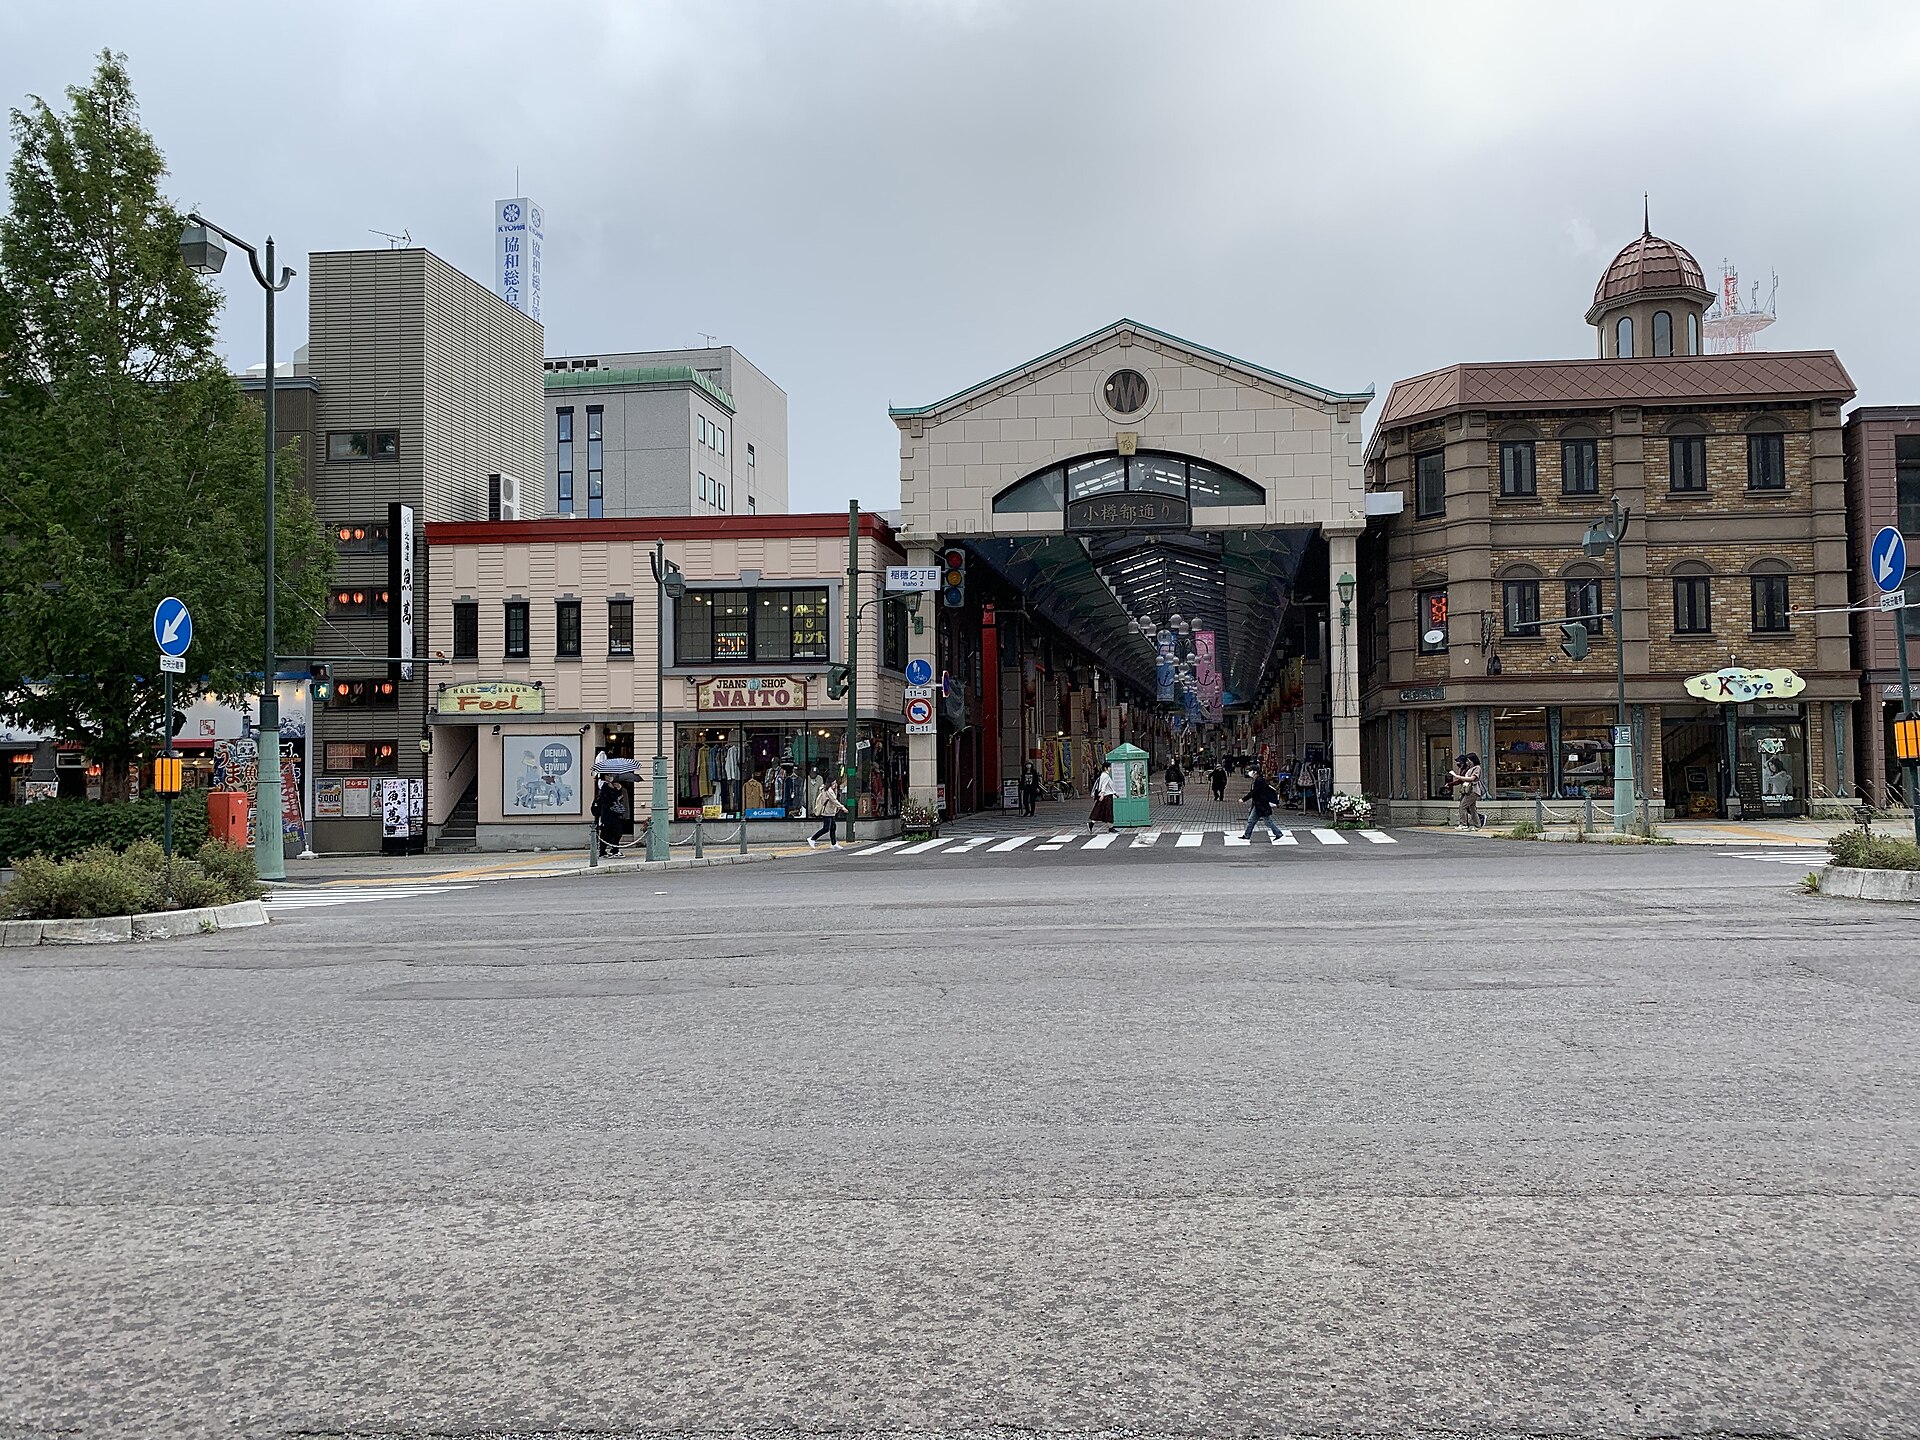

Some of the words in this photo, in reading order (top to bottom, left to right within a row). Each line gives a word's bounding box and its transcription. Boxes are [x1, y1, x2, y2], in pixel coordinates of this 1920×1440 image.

[1083, 503, 1172, 521] 小樽都通り
[890, 570, 937, 580] 稲穂2丁目
[793, 631, 826, 643] カット
[716, 679, 747, 689] JEANS
[761, 679, 786, 688] SHOP
[457, 695, 523, 711] Feel
[712, 690, 790, 707] NAITO
[544, 749, 567, 758] DENIM
[544, 763, 568, 771] EDWIN
